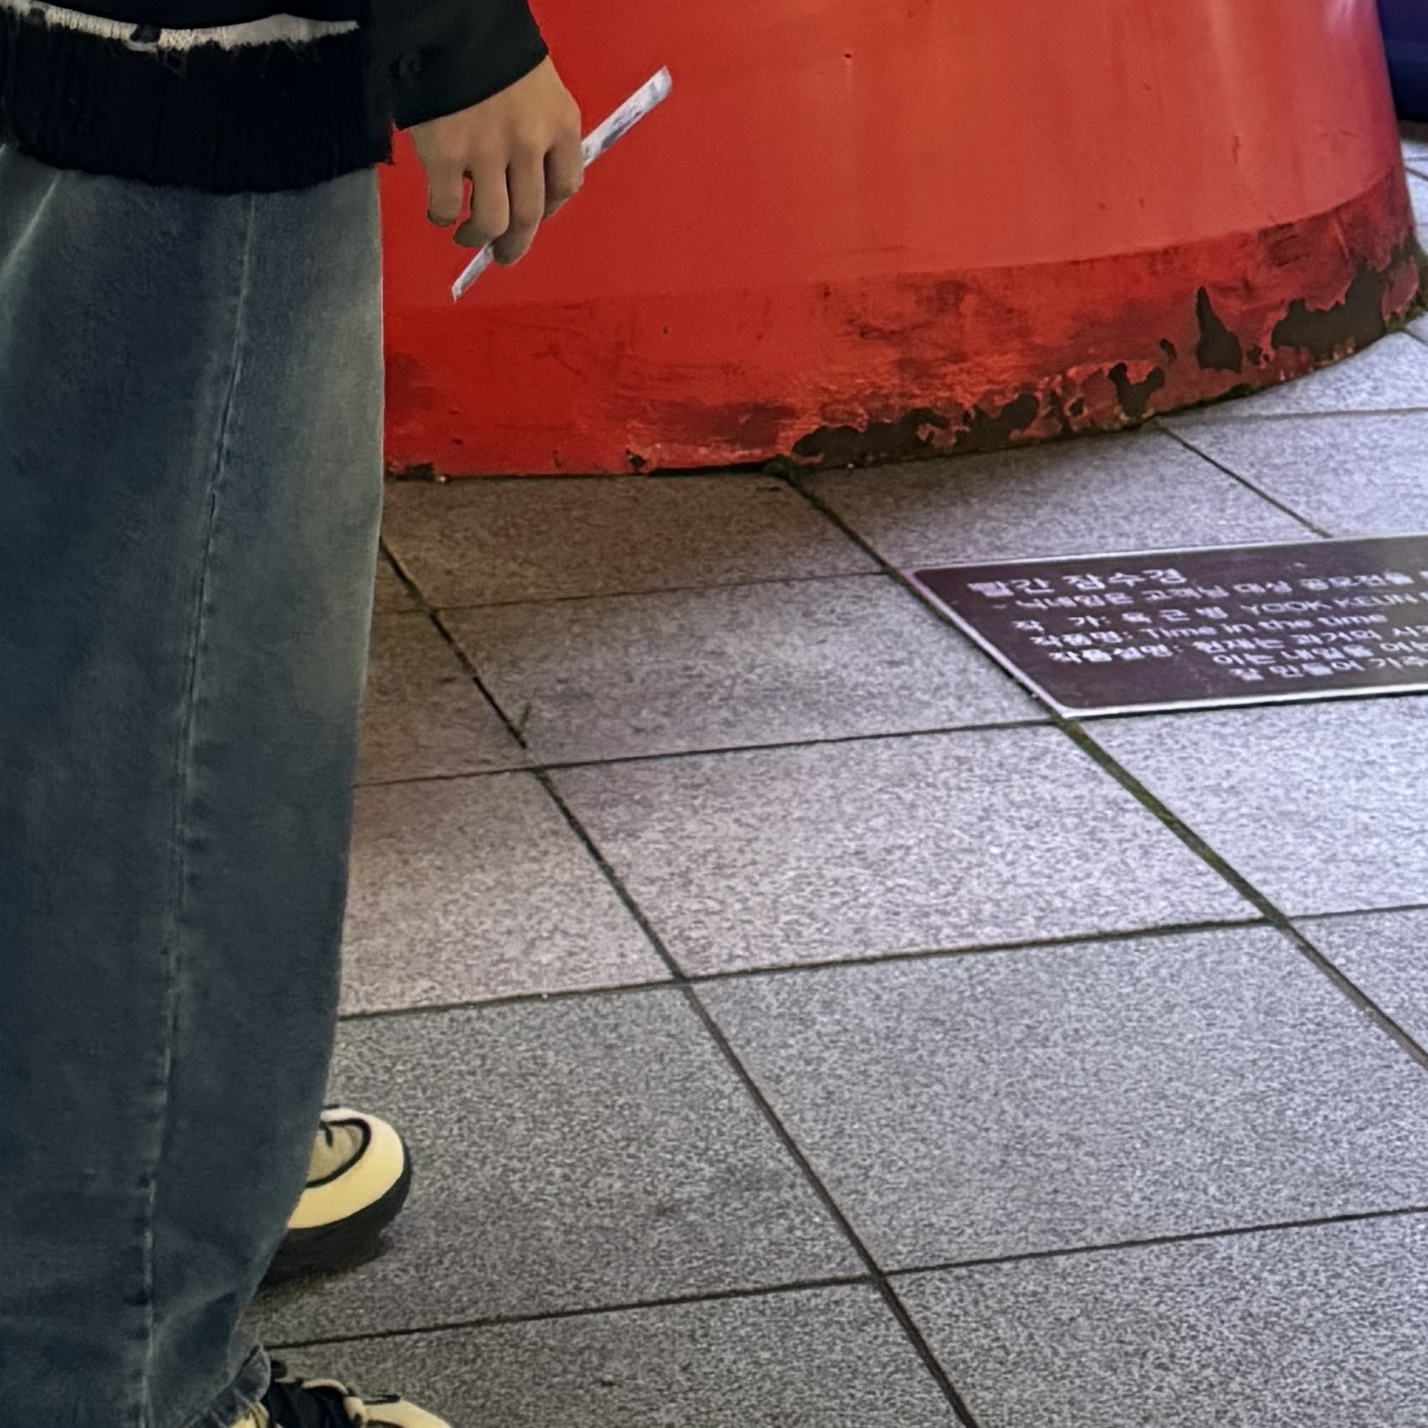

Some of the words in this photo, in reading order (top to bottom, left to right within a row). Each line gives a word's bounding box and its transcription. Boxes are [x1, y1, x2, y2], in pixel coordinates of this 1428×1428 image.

[968, 578, 1055, 597] 빨간
[1062, 568, 1187, 591] 잠수경
[1140, 626, 1217, 639] Time
[1258, 619, 1314, 630] the
[1318, 614, 1388, 626] time
